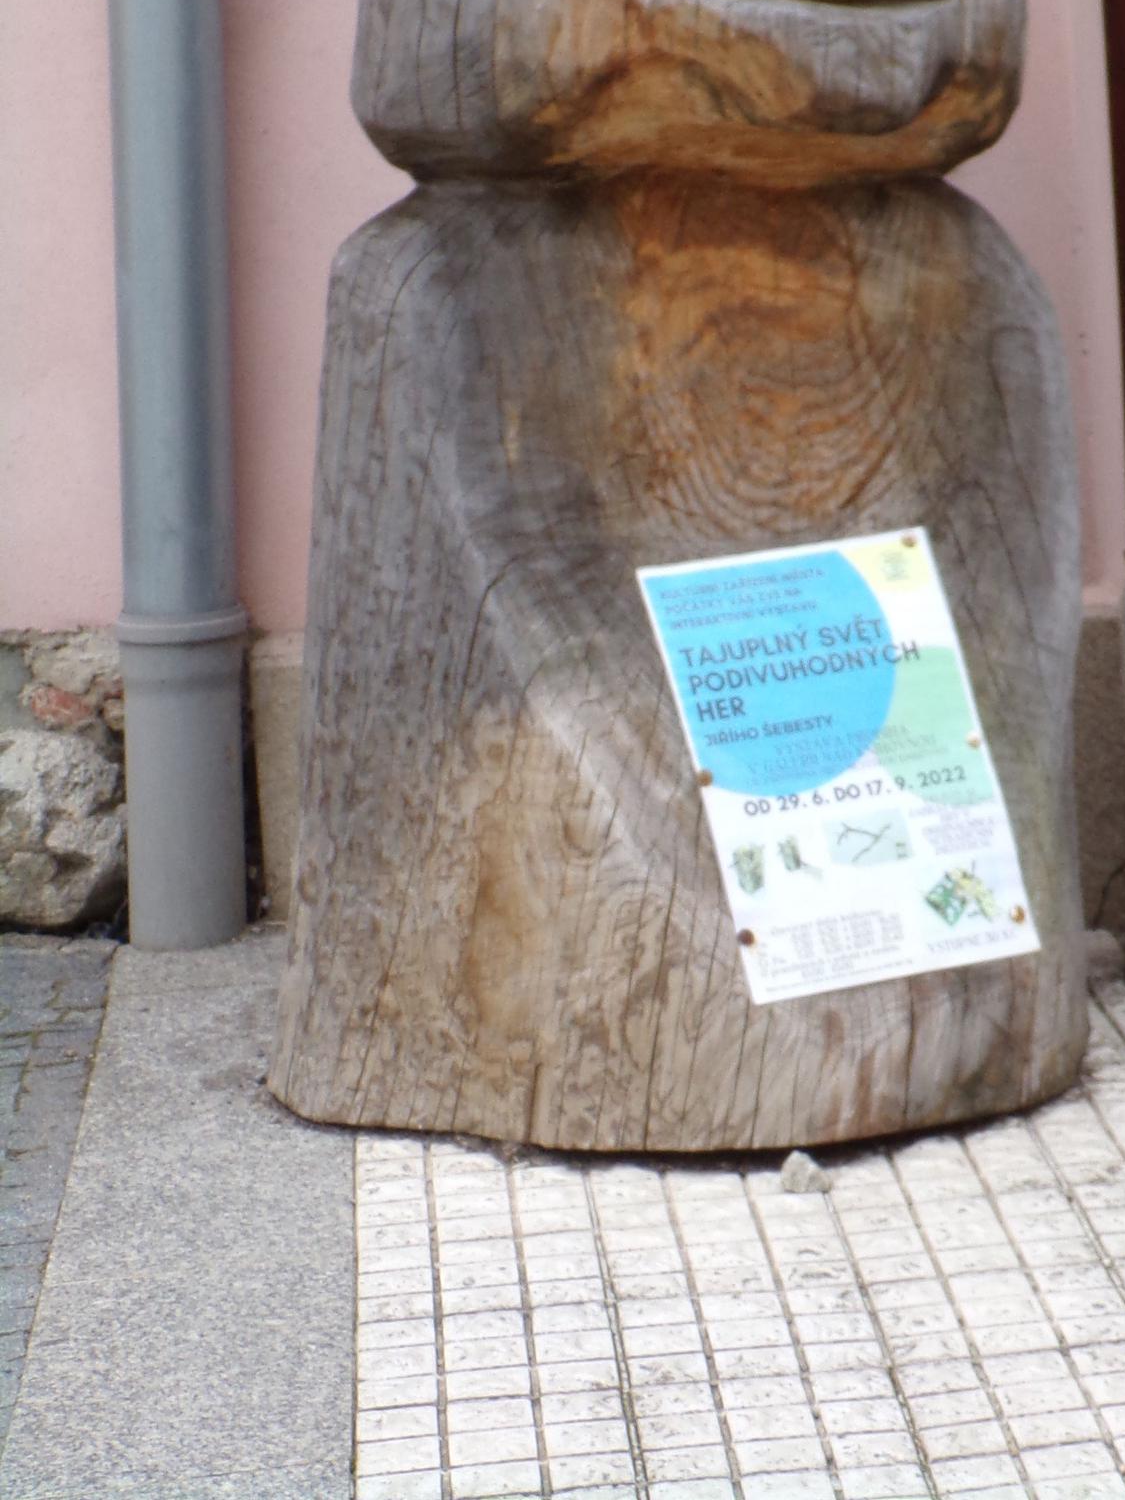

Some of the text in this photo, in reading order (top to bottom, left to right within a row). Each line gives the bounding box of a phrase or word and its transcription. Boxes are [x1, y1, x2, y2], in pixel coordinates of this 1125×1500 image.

[680, 614, 883, 667] TAJUPLNÝ SVĚT
[689, 640, 920, 695] PODIVUHODNÝCH
[696, 697, 746, 722] HER
[704, 715, 834, 747] JIŘÍHO ŠEBESTY
[744, 766, 966, 816] OD 29. 6. DO 17. 9. 2022
